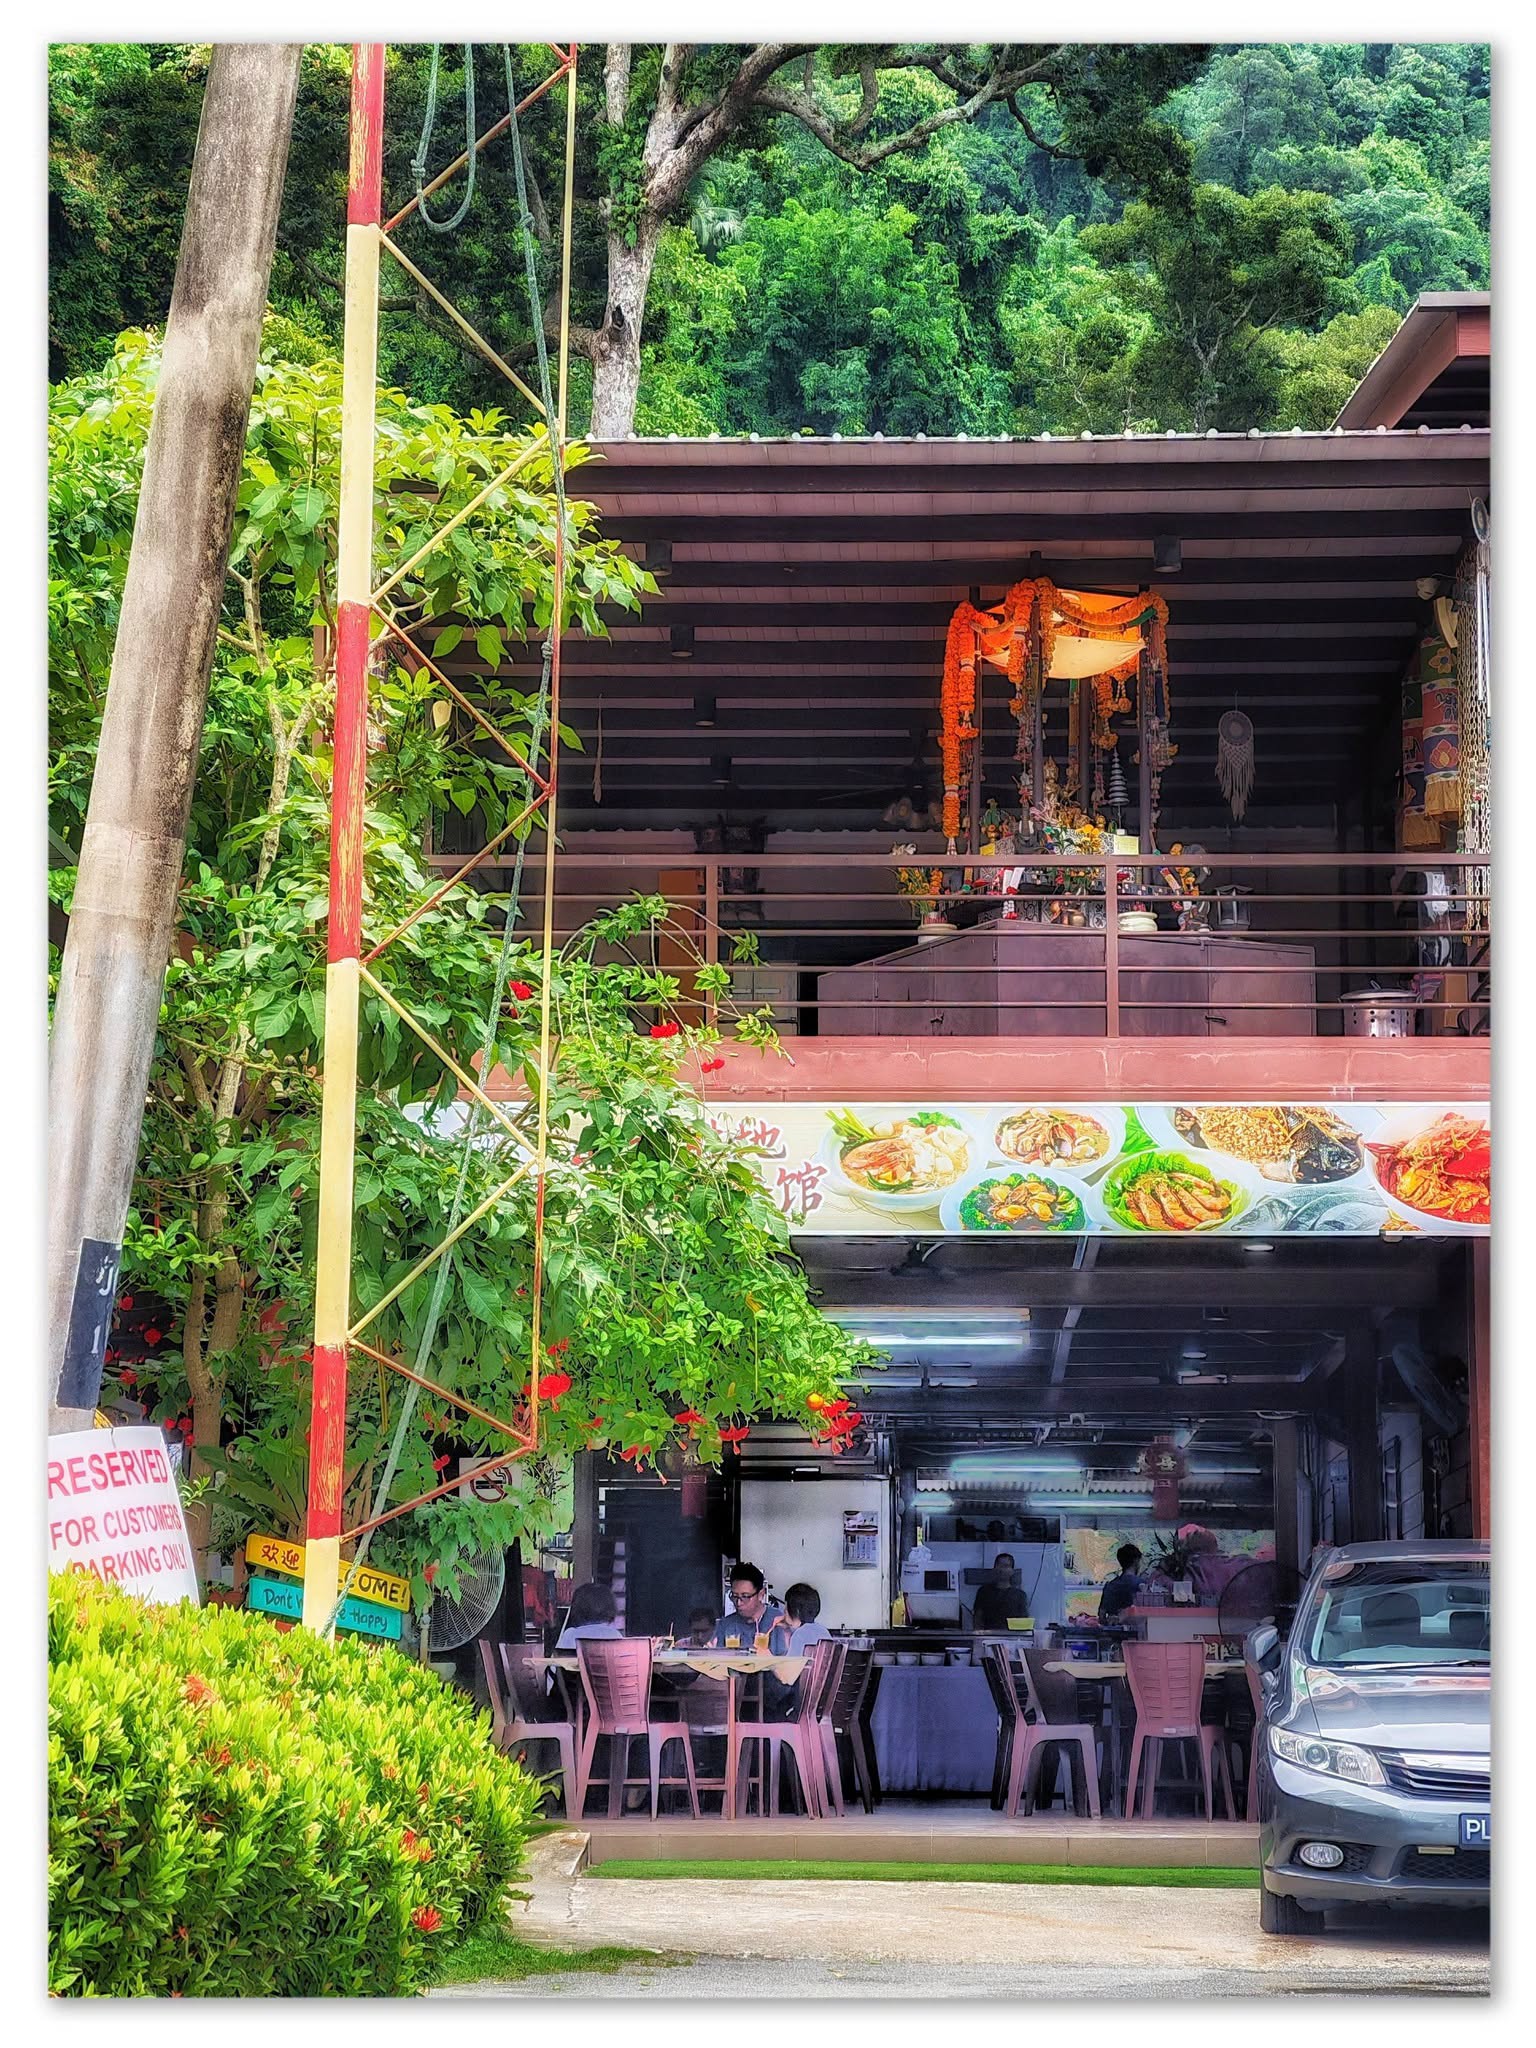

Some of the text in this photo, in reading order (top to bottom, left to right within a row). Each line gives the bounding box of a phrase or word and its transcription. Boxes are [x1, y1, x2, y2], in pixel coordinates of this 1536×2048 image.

[48, 1449, 169, 1500] RESERVED
[49, 1503, 183, 1551] FOR CUSTOMERS
[161, 1543, 188, 1571] ONLY
[261, 1543, 301, 1571] 欢迎
[263, 1587, 293, 1610] Don't
[351, 1607, 388, 1634] Happy
